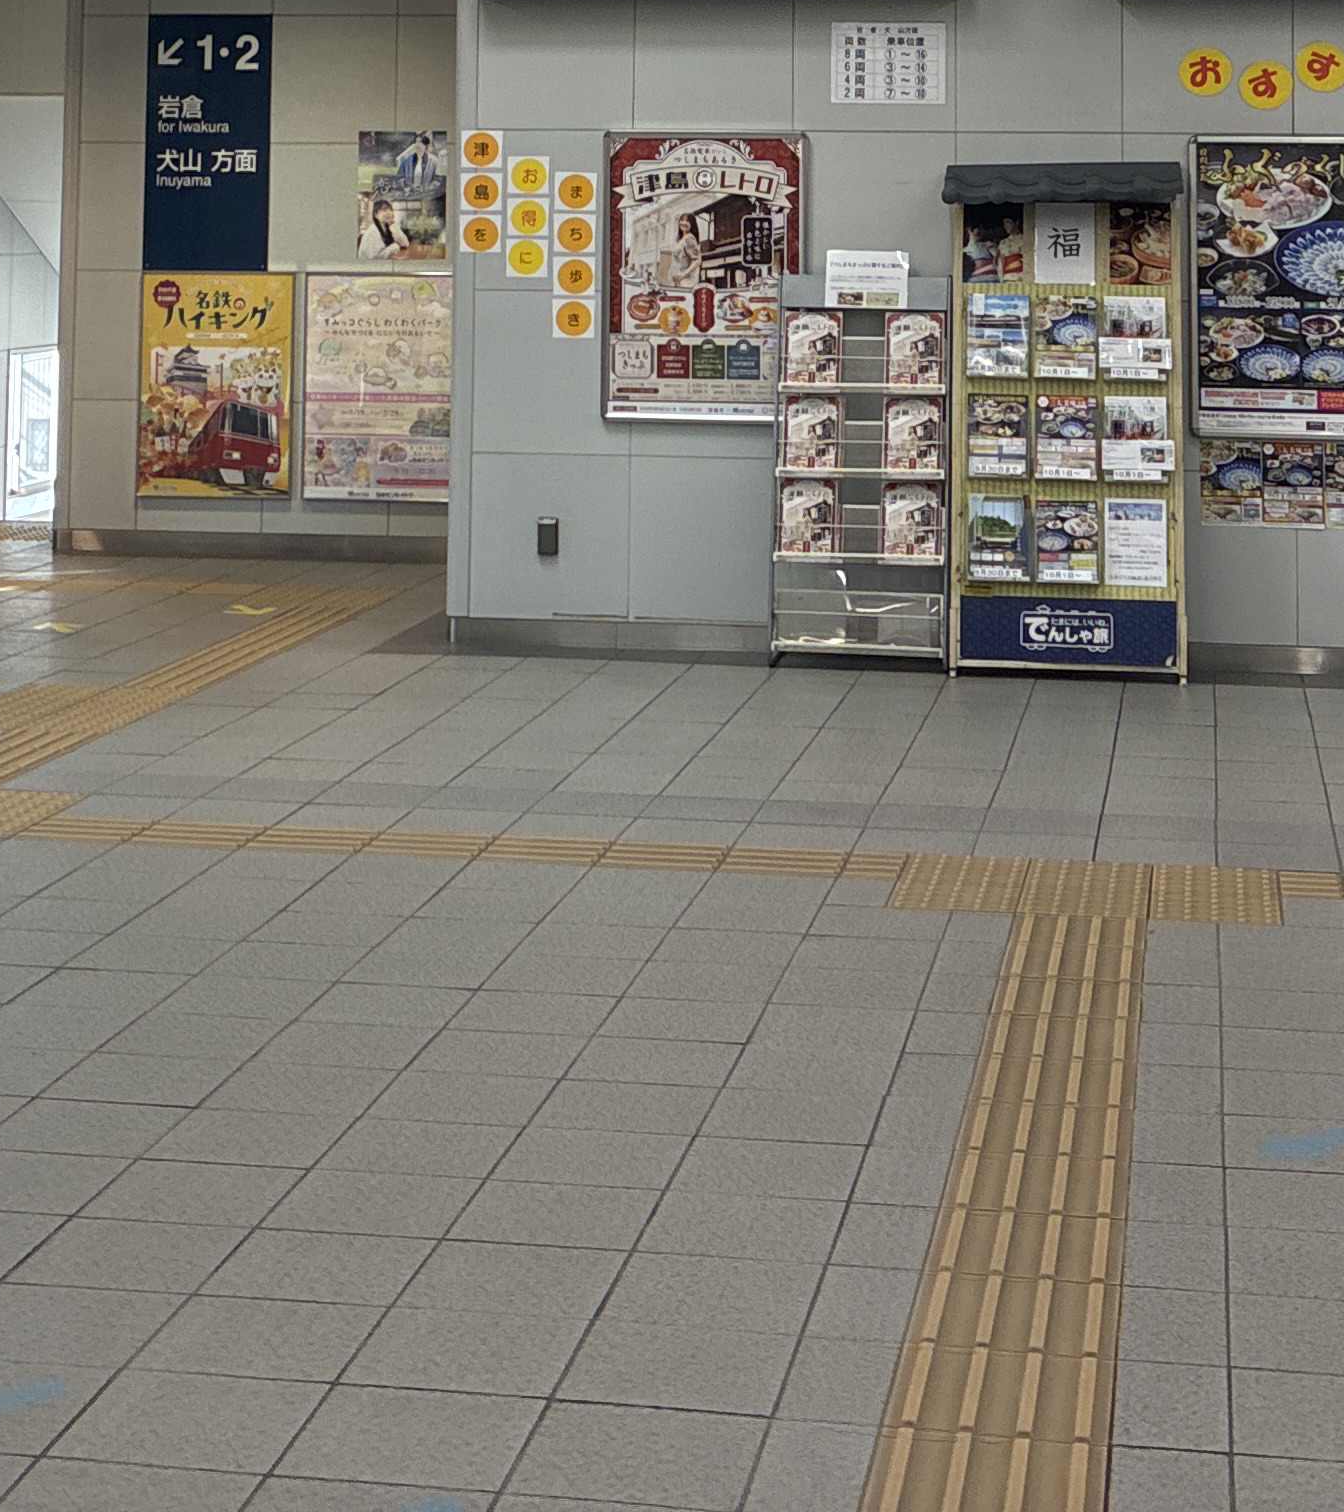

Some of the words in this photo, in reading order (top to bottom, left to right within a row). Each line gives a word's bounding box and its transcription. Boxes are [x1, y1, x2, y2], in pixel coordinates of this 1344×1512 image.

[158, 95, 203, 119] 岩倉
[158, 120, 175, 133] for
[178, 121, 229, 134] Iwakura
[156, 148, 202, 173] 犬山
[211, 148, 257, 173] 方面
[156, 174, 212, 190] Inuyama
[720, 171, 775, 195] レトロ
[1047, 227, 1081, 259] 福
[163, 298, 272, 330] ハイキング
[1024, 616, 1110, 645] でんしゃ旅
